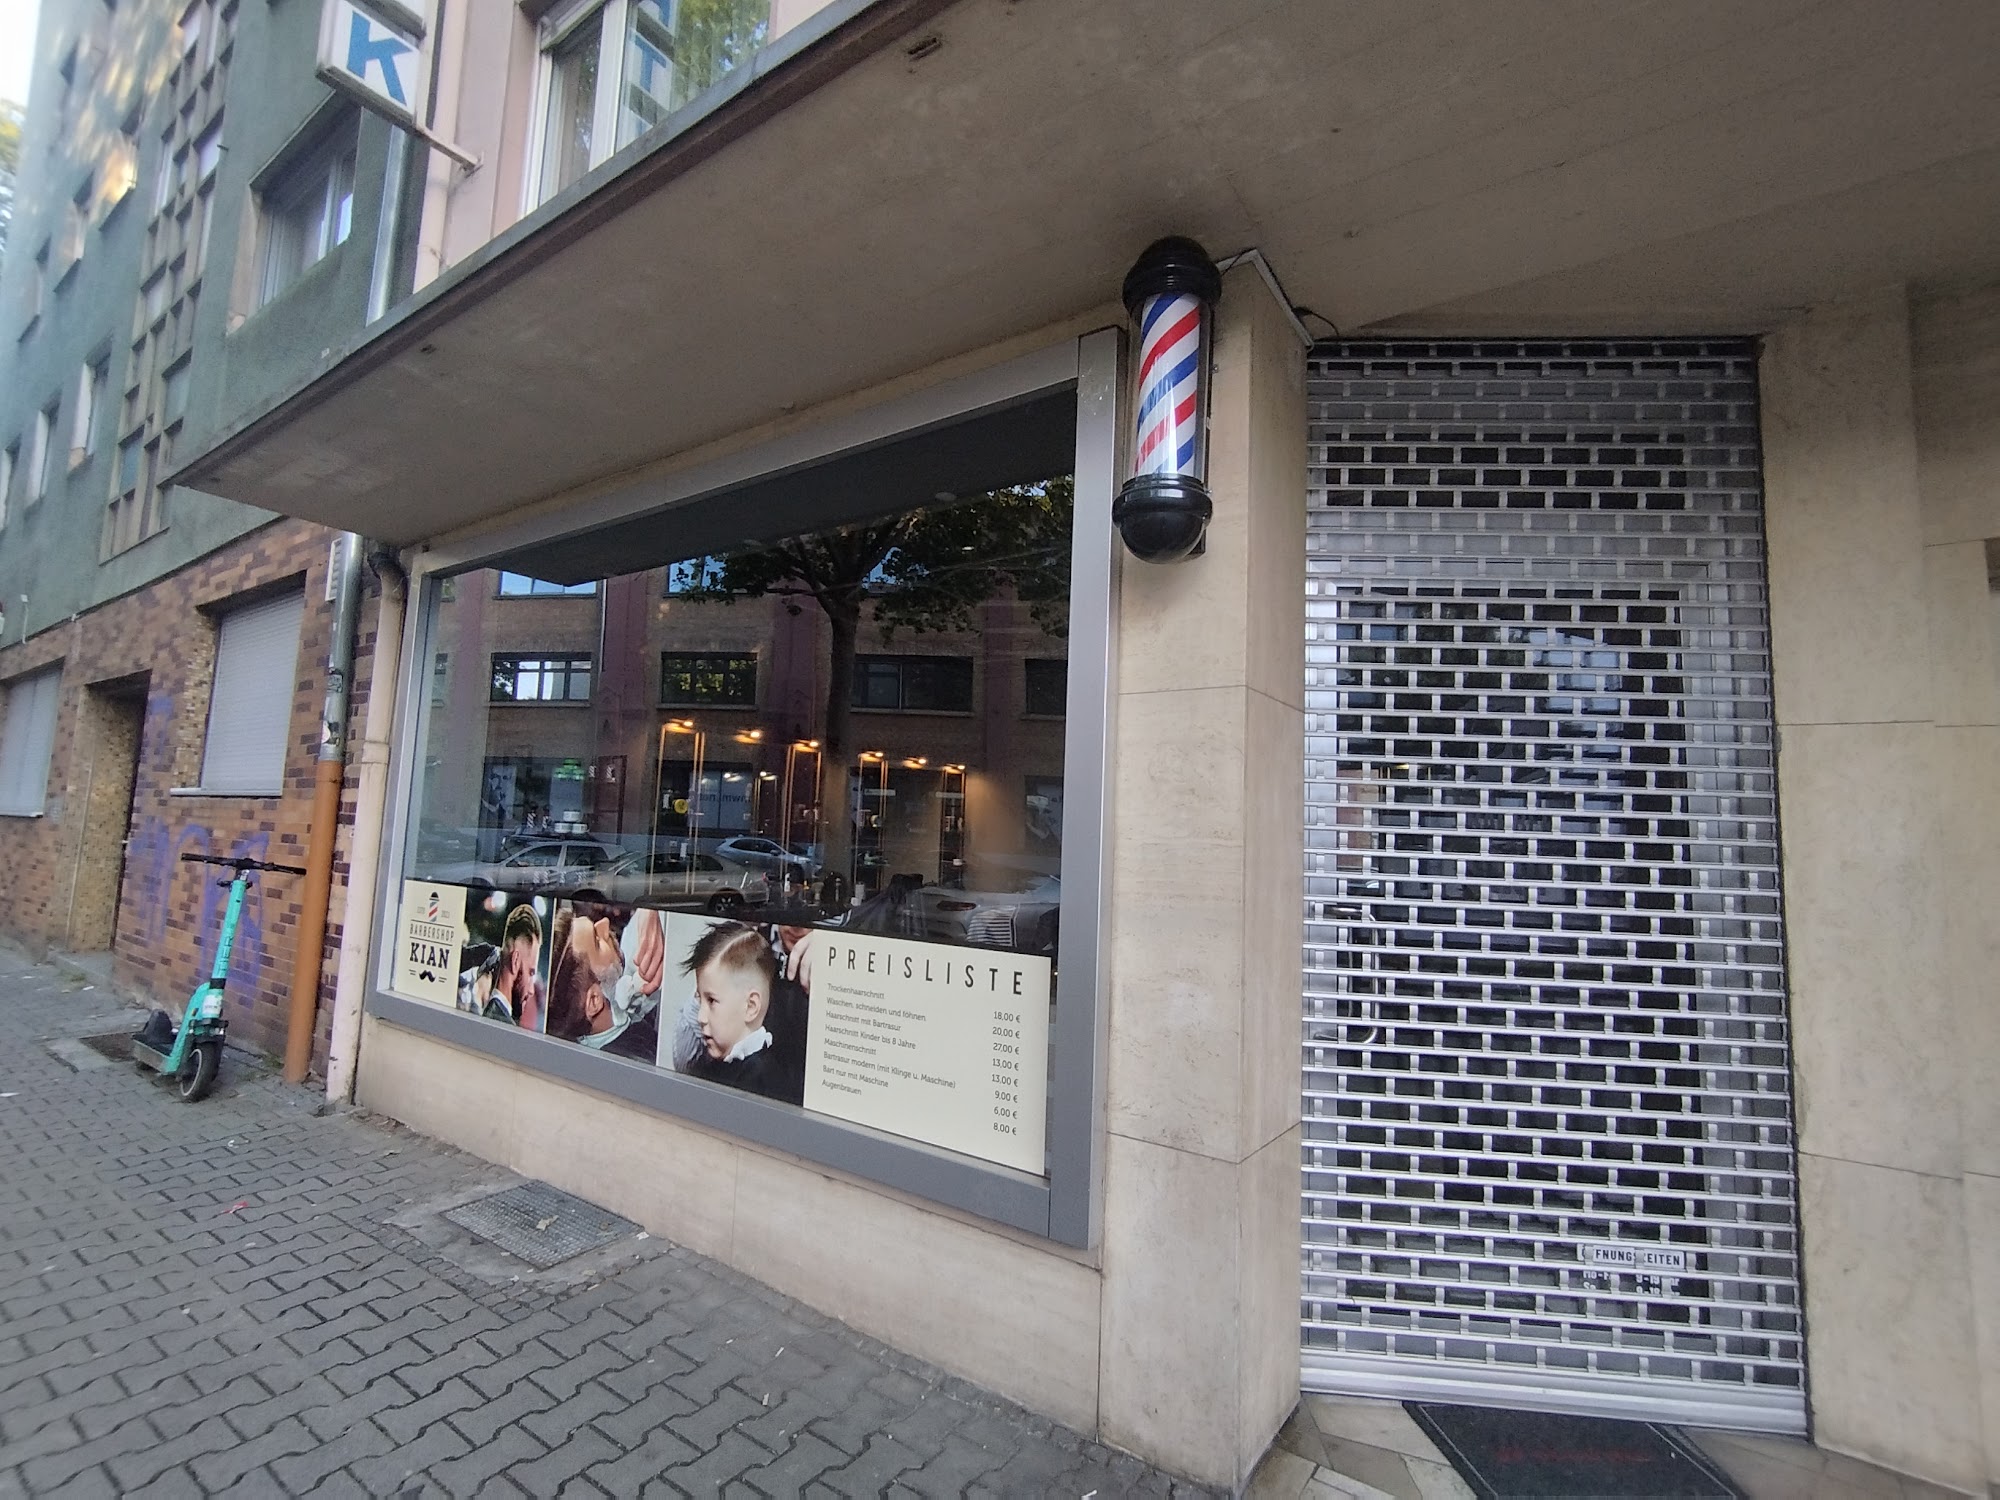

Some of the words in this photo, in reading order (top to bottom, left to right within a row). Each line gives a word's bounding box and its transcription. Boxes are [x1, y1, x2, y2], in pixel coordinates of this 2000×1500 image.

[346, 9, 413, 107] K
[409, 942, 450, 969] KIAN
[410, 923, 455, 942] BARBERSHOP
[829, 946, 1023, 996] PREISLISTE
[825, 1010, 860, 1024] Haarschnitt
[872, 1019, 902, 1032] Bartrasur
[992, 1042, 1013, 1054] 27,00
[1014, 1047, 1020, 1055] €
[855, 1003, 888, 1015] schneiden
[991, 1026, 1014, 1038] 20,00
[1014, 1031, 1020, 1039] €
[993, 1011, 1014, 1022] 18,00
[1015, 1015, 1021, 1024] €
[823, 1038, 877, 1056] Maschinenschnitt
[991, 1074, 1012, 1086] 13,00
[1013, 1079, 1019, 1088] €
[824, 1024, 859, 1038] Haarschnitt
[859, 1031, 881, 1042] Kinder
[881, 1035, 891, 1045] bis
[891, 1037, 897, 1046] 8
[897, 1039, 916, 1050] Jahre
[992, 1058, 1013, 1070] 13,00
[1013, 1063, 1019, 1072] €
[822, 1065, 835, 1075] Bart
[847, 1073, 858, 1081] mit
[858, 1074, 889, 1088] Maschine
[993, 1106, 1011, 1118] 6,00
[1011, 1111, 1017, 1120] €
[823, 1051, 851, 1064] Bartrasur
[850, 1059, 876, 1070] modern
[876, 1064, 890, 1074] (mit
[890, 1066, 912, 1079] Klinge
[920, 1074, 956, 1089] Maschine)
[994, 1090, 1012, 1102] 9,00
[1012, 1095, 1018, 1104] €
[821, 1079, 862, 1096] Augenbrauen
[992, 1122, 1010, 1134] 8,00
[1011, 1127, 1017, 1136] €
